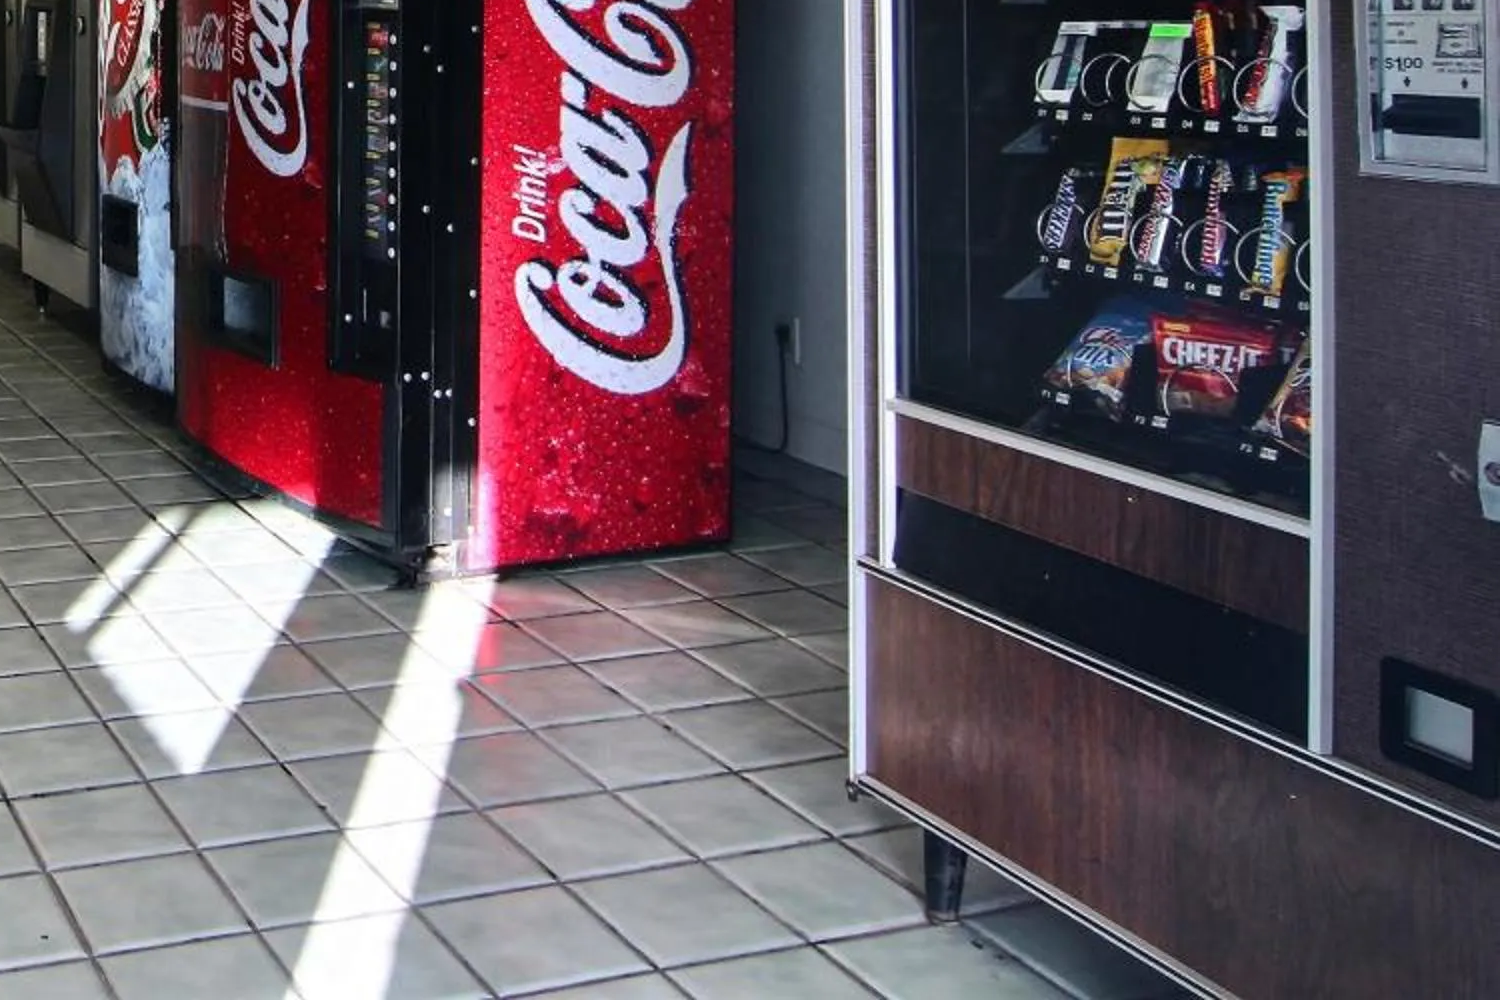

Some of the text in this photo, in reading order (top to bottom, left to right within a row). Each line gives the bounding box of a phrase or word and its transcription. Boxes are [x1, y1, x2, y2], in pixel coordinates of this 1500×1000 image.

[231, 0, 246, 66] Drink!
[512, 143, 548, 243] Drink!
[1162, 337, 1266, 373] CHEEZ-IT
